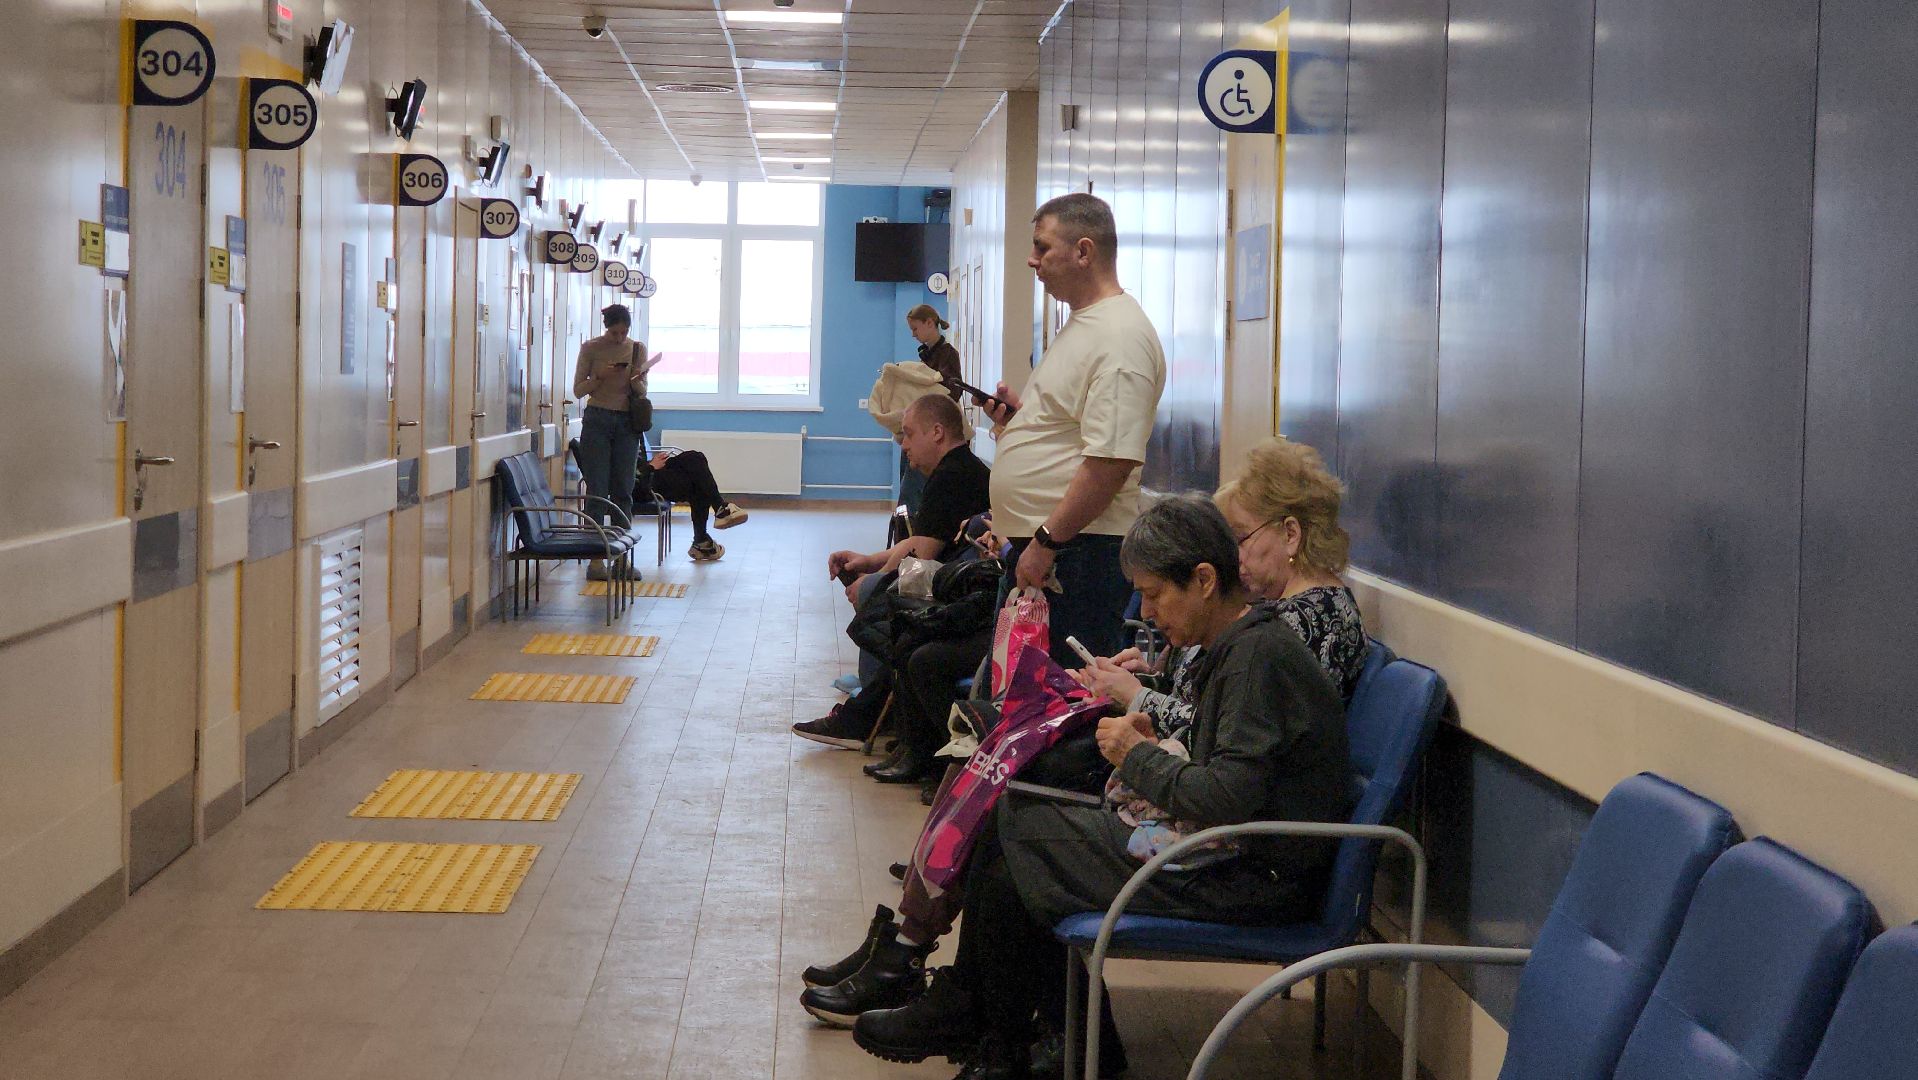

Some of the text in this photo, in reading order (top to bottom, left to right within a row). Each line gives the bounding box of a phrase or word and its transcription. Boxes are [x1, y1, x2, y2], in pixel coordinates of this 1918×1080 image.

[141, 50, 203, 77] 304
[257, 103, 308, 126] 305
[155, 119, 187, 199] 304
[404, 171, 443, 188] 306
[485, 211, 515, 225] 307
[549, 242, 574, 253] 308
[573, 253, 596, 263] 309
[607, 269, 625, 279] 310
[643, 283, 654, 292] 12
